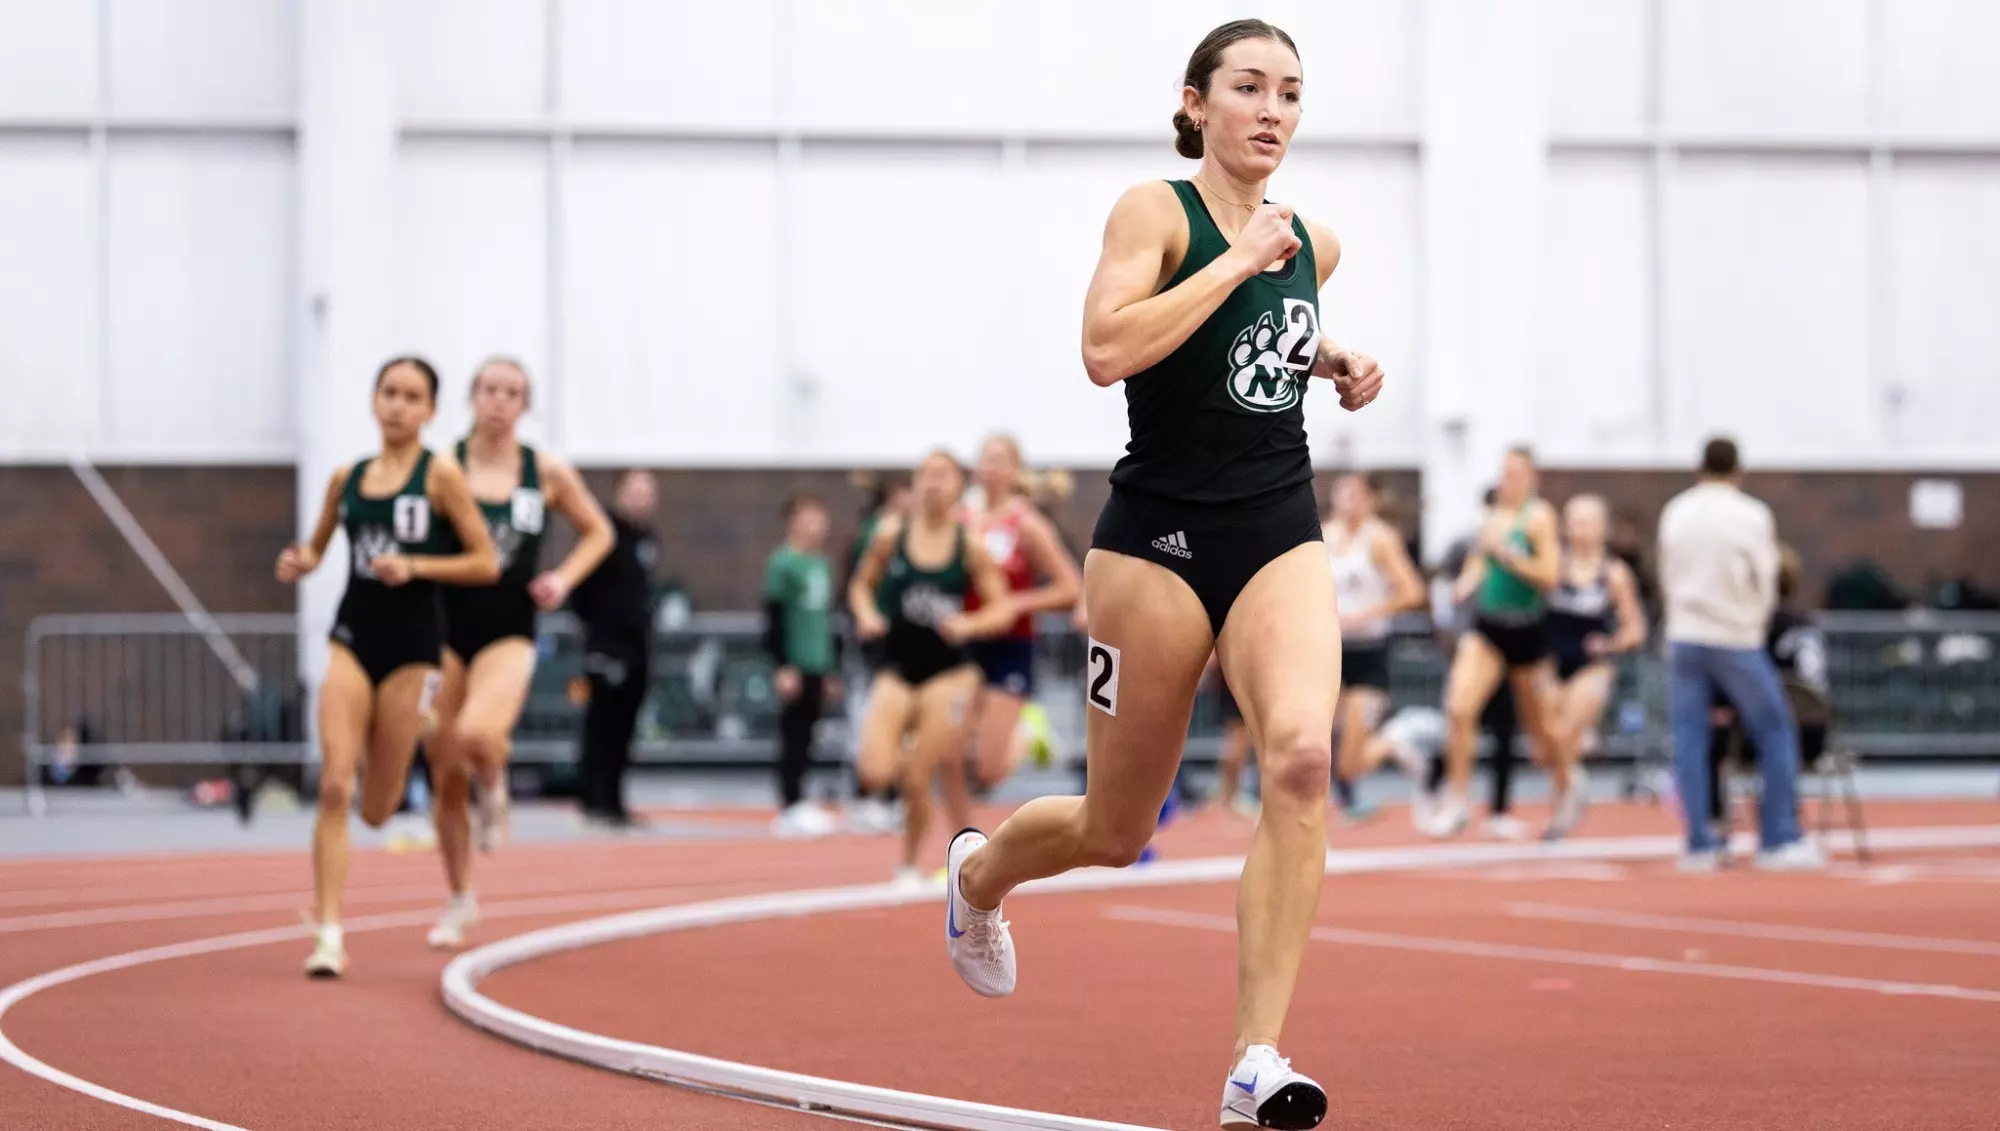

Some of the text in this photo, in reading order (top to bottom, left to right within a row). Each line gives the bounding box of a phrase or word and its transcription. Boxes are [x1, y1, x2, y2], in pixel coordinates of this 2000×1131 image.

[1286, 304, 1314, 366] 2
[1243, 364, 1282, 398] N
[1151, 540, 1193, 559] adidas
[1090, 646, 1113, 709] 2
